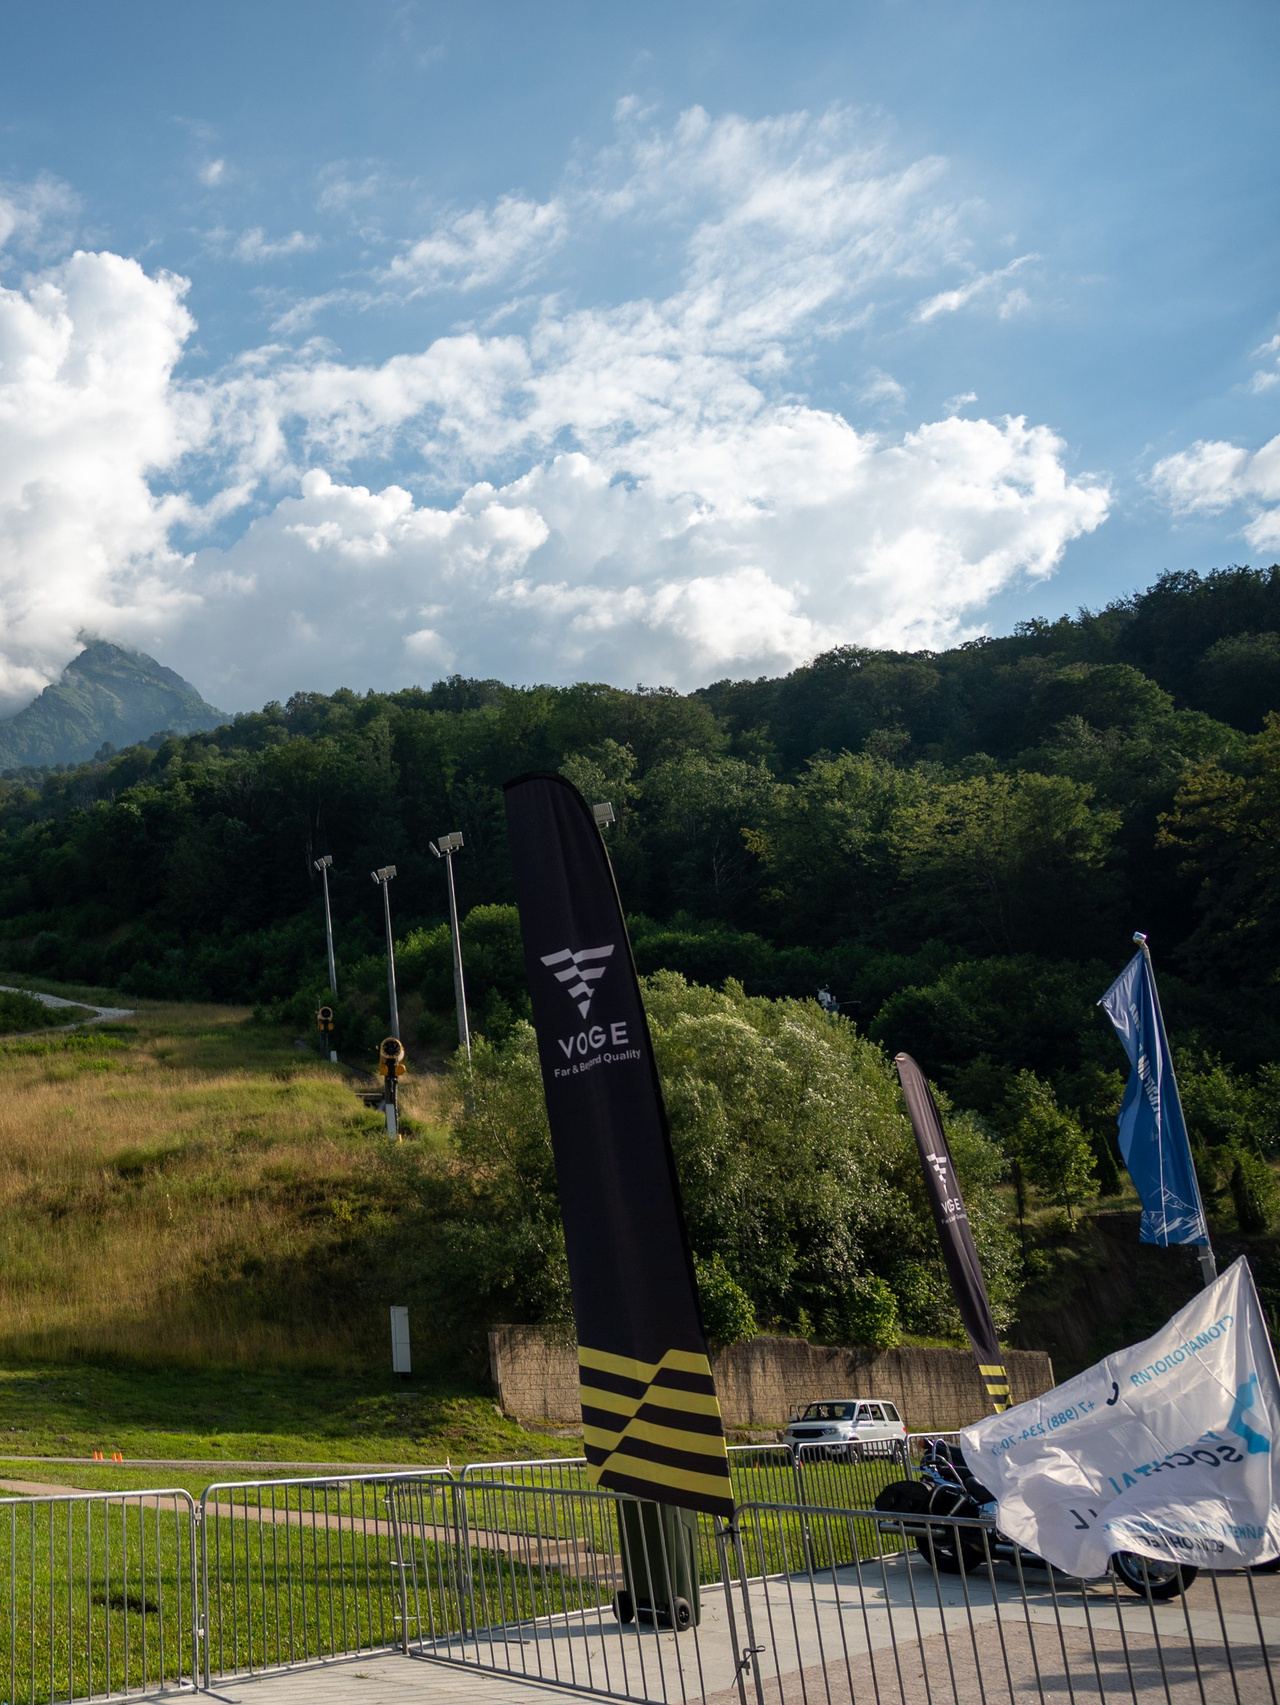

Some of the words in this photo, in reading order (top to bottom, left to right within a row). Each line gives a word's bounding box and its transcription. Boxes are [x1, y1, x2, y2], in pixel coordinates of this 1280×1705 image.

[558, 1021, 629, 1059] VOGE
[554, 1067, 571, 1078] Far
[603, 1048, 641, 1063] Quality
